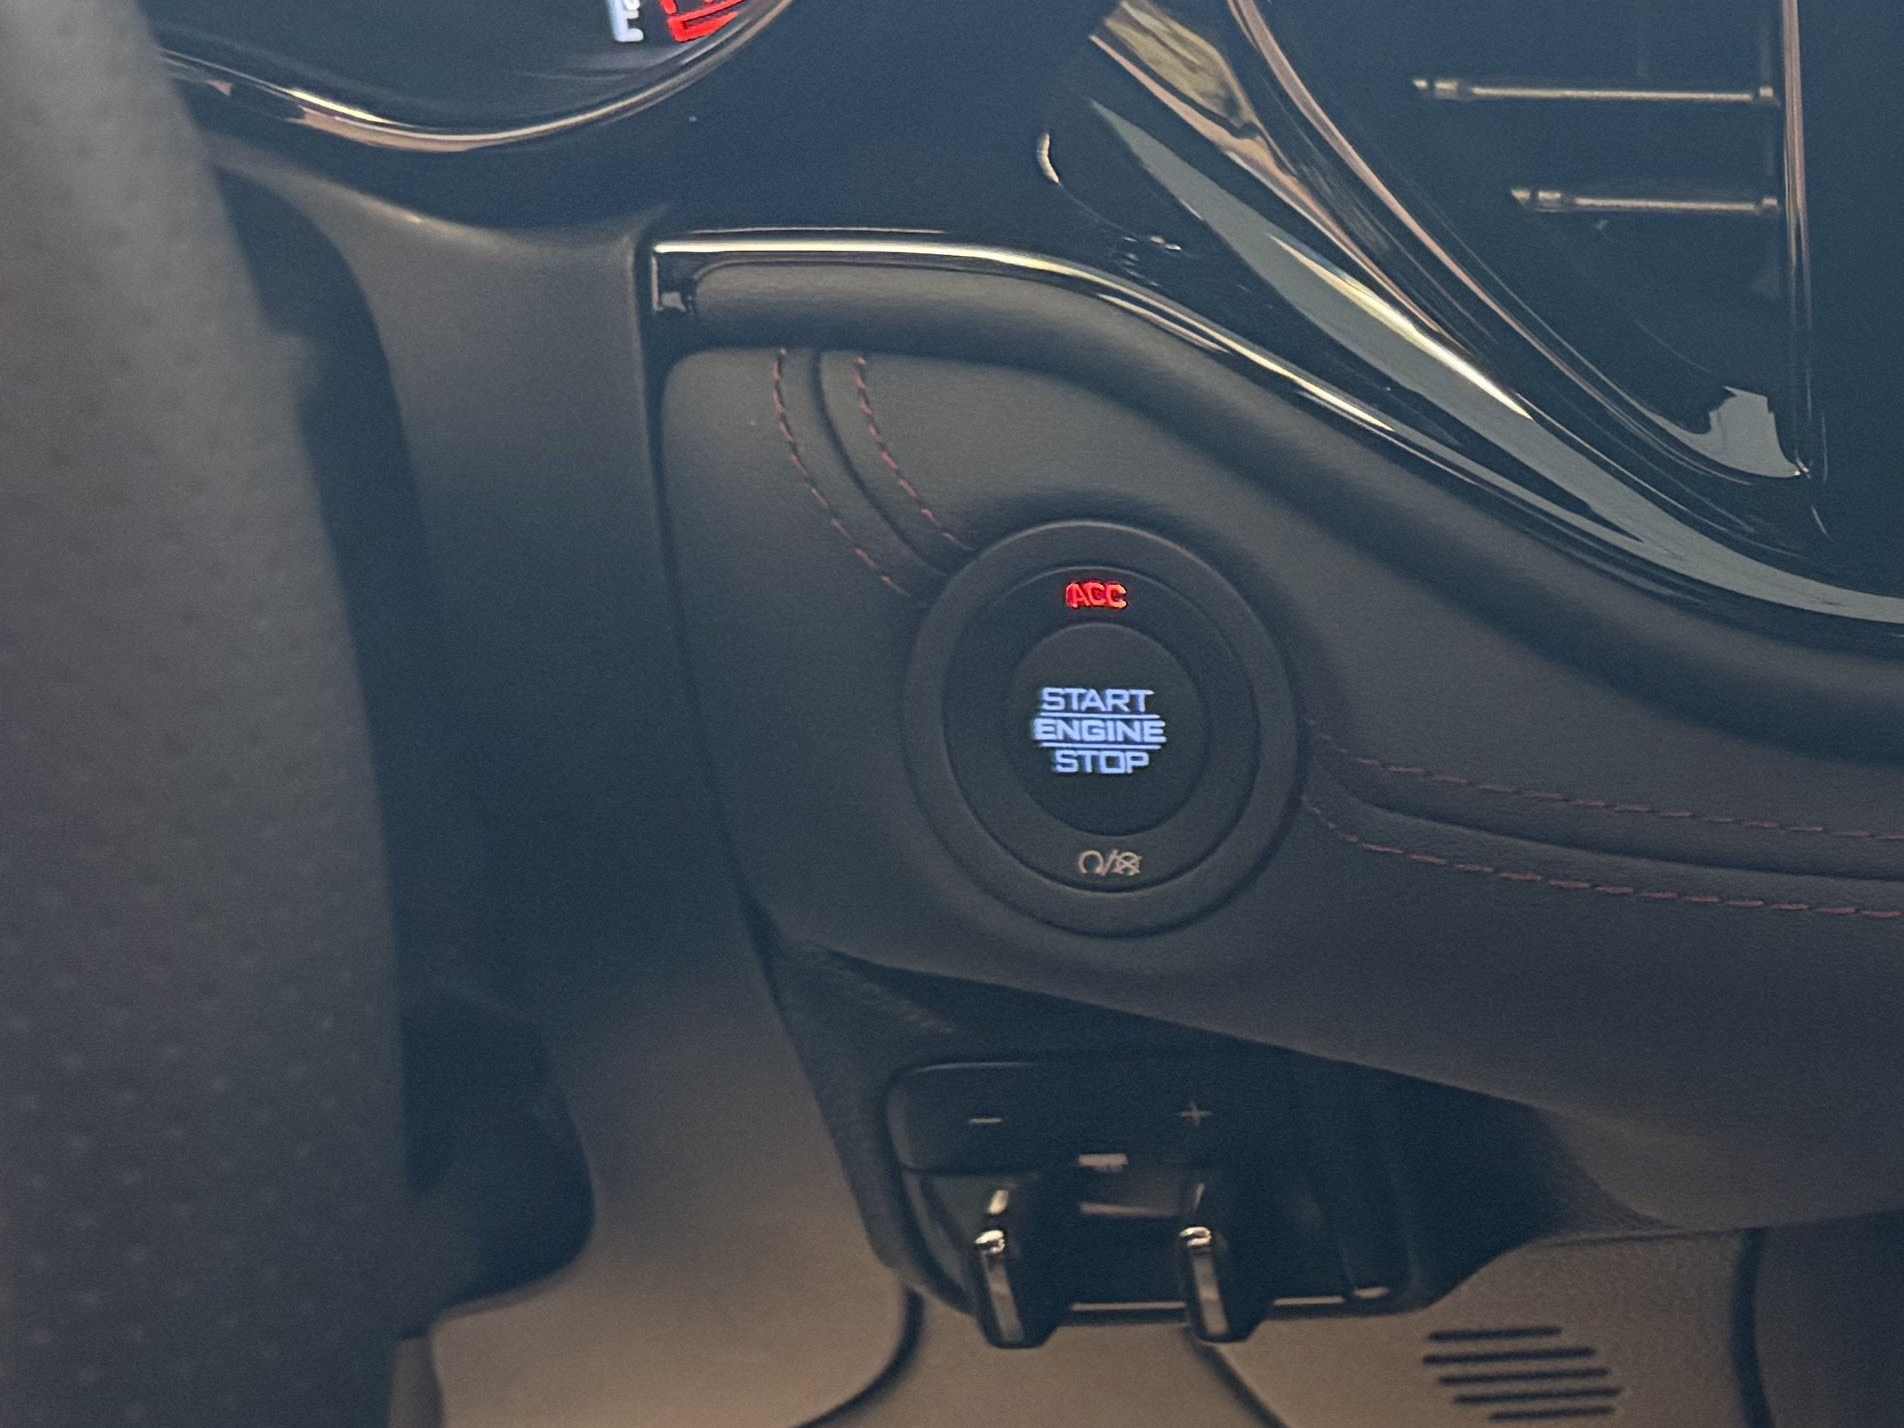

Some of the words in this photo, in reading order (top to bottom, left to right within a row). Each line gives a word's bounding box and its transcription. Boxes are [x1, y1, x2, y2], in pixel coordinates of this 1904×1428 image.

[1066, 582, 1127, 608] ACC
[1042, 687, 1154, 712] START
[1033, 718, 1166, 743] ENGINE
[1055, 750, 1149, 773] STOP
